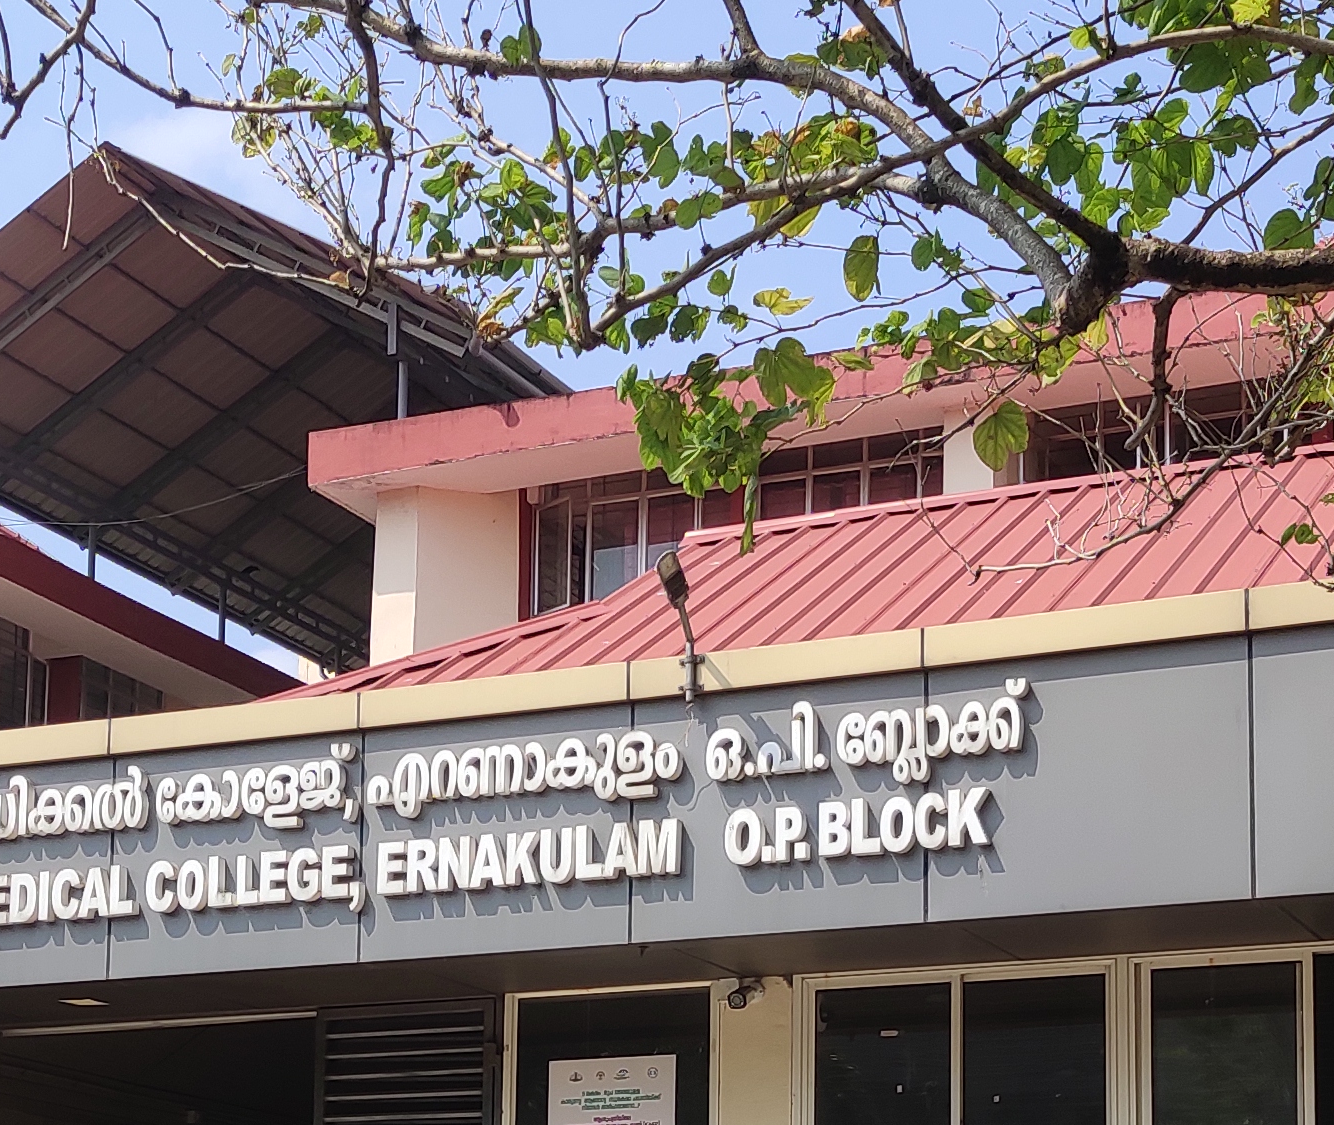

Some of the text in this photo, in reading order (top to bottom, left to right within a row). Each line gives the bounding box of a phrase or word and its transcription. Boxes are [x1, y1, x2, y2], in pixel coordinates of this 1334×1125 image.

[367, 730, 685, 820] എറണാകുളം
[146, 843, 364, 914] COLLEGE,
[376, 817, 683, 898] ERNAKULAM
[723, 806, 812, 867] O.P.
[817, 786, 996, 858] BLOCK
